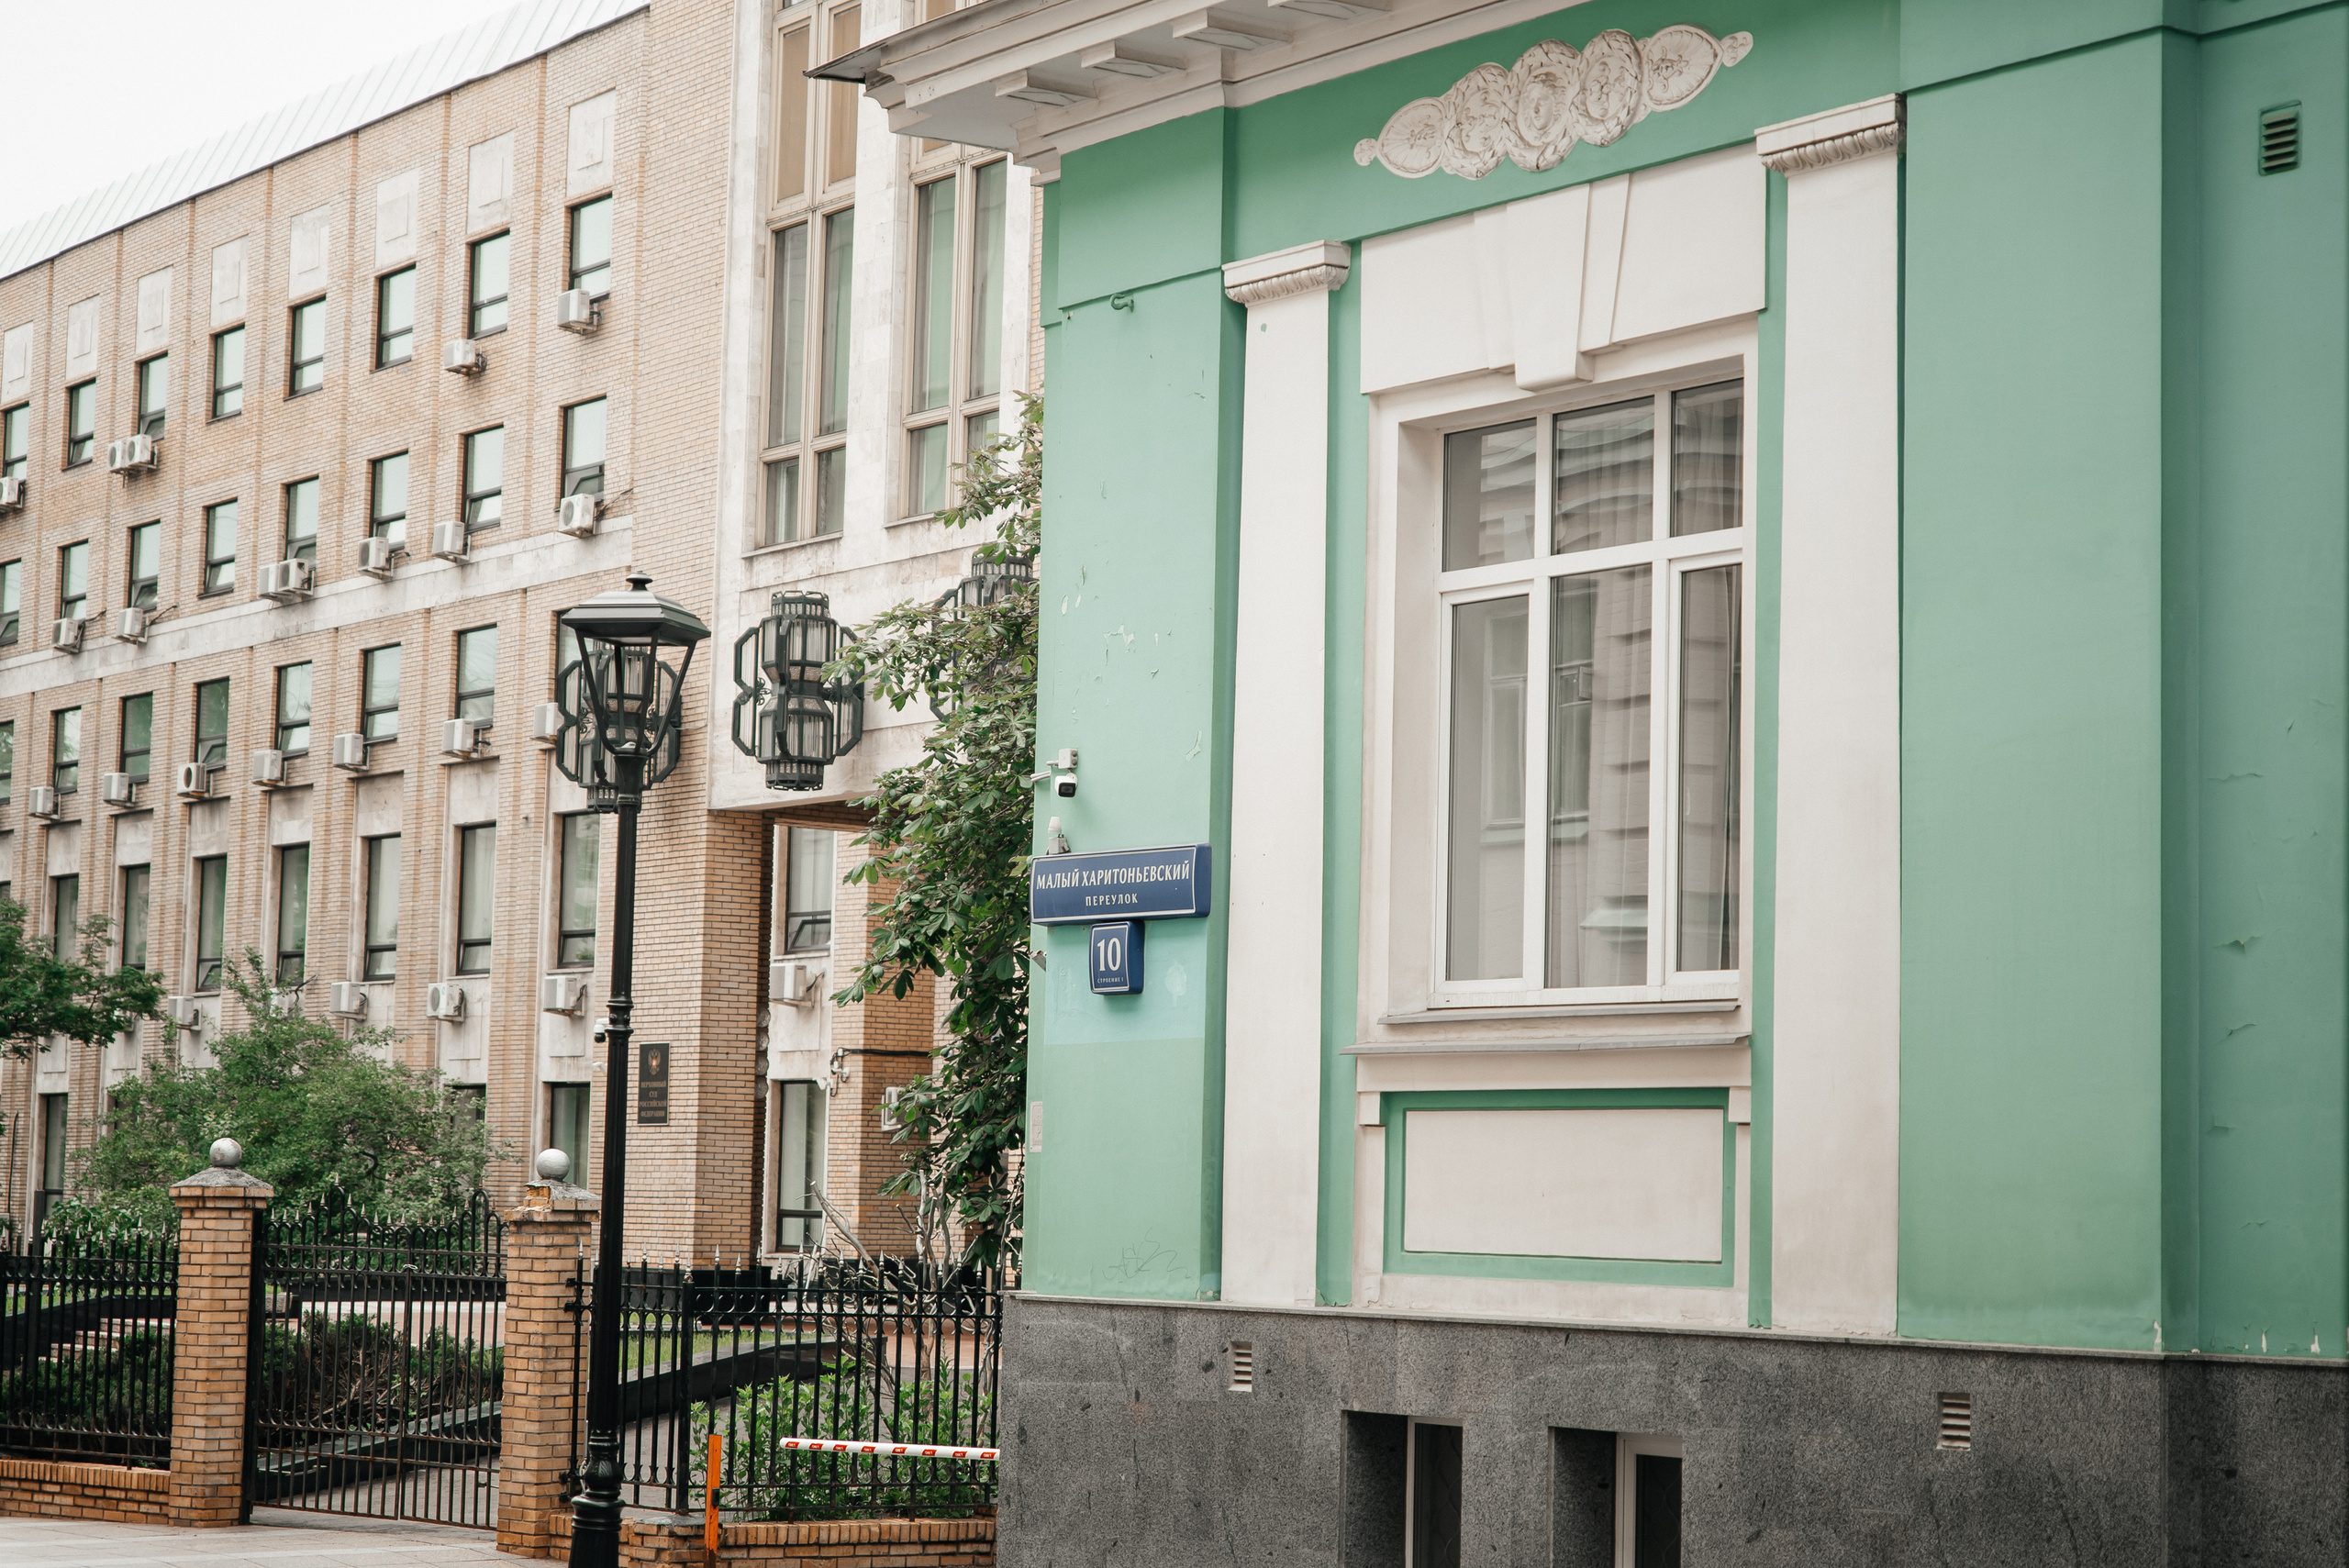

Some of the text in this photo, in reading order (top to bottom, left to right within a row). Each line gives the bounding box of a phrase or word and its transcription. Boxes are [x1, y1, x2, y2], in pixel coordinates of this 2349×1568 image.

[1036, 860, 1190, 890] МАЛЫЙ ХАРИТОНЬЕВСКИЙ
[1085, 893, 1139, 906] ПЕРЕУЛОК
[1097, 937, 1121, 972] 10
